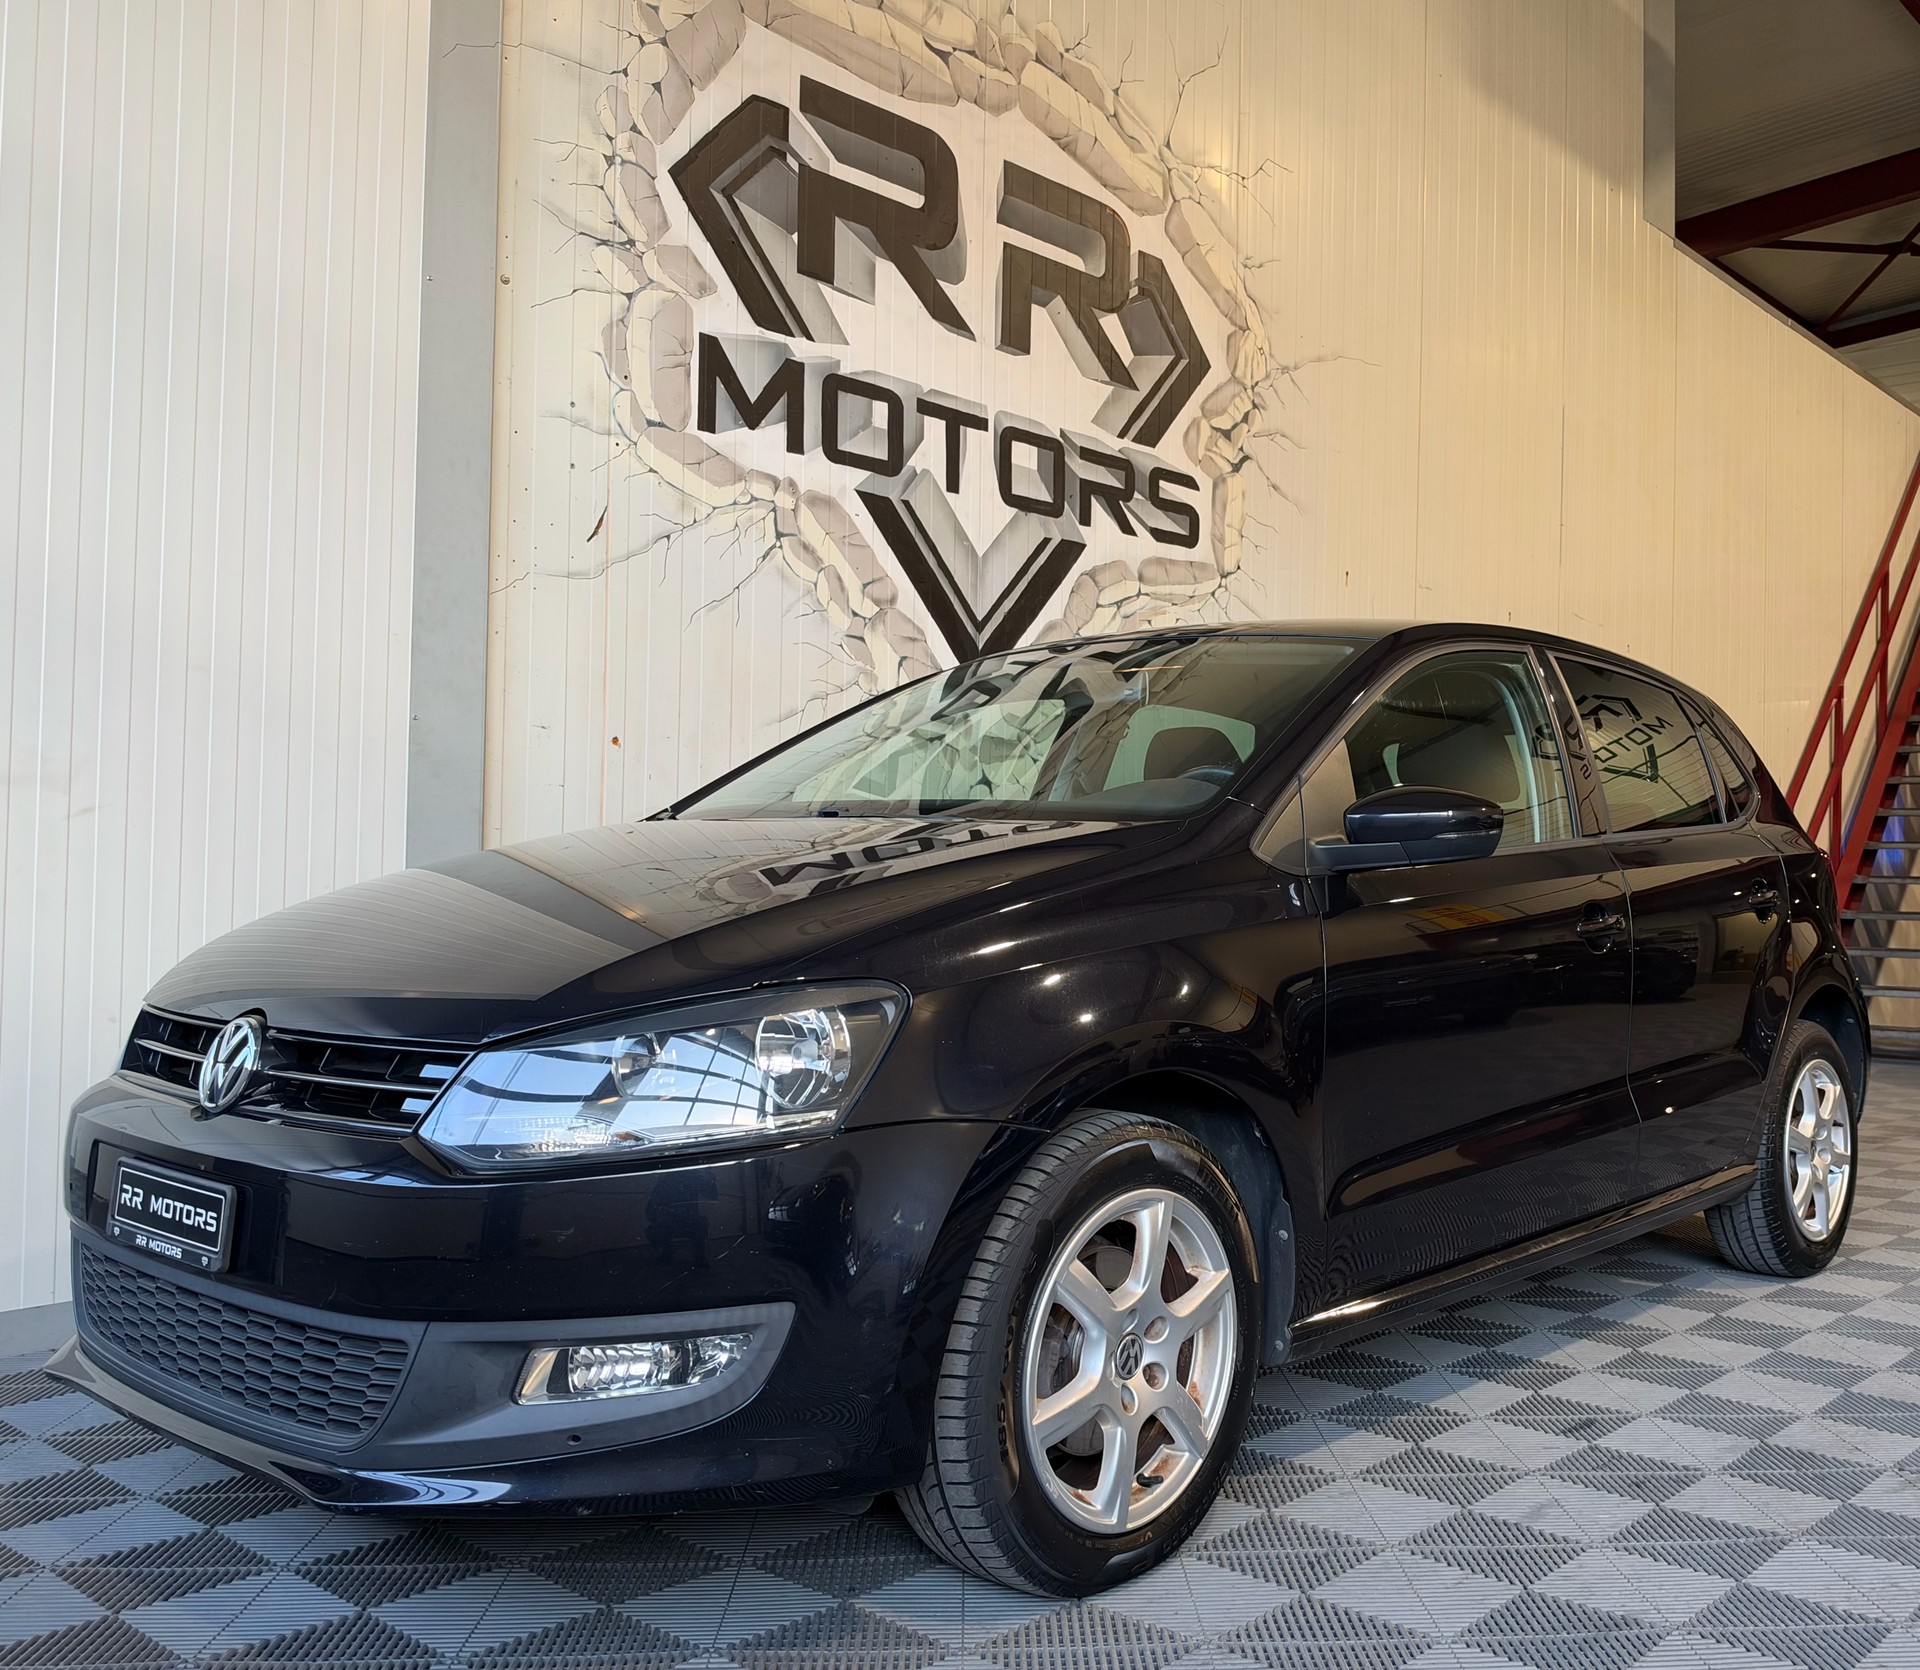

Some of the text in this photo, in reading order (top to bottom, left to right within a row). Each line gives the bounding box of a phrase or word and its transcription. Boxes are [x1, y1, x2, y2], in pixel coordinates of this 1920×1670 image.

[797, 75, 1137, 390] RR
[697, 332, 1200, 549] MOTORS
[121, 1184, 218, 1232] RR MOTORS
[136, 1235, 182, 1259] RR MOTORS
